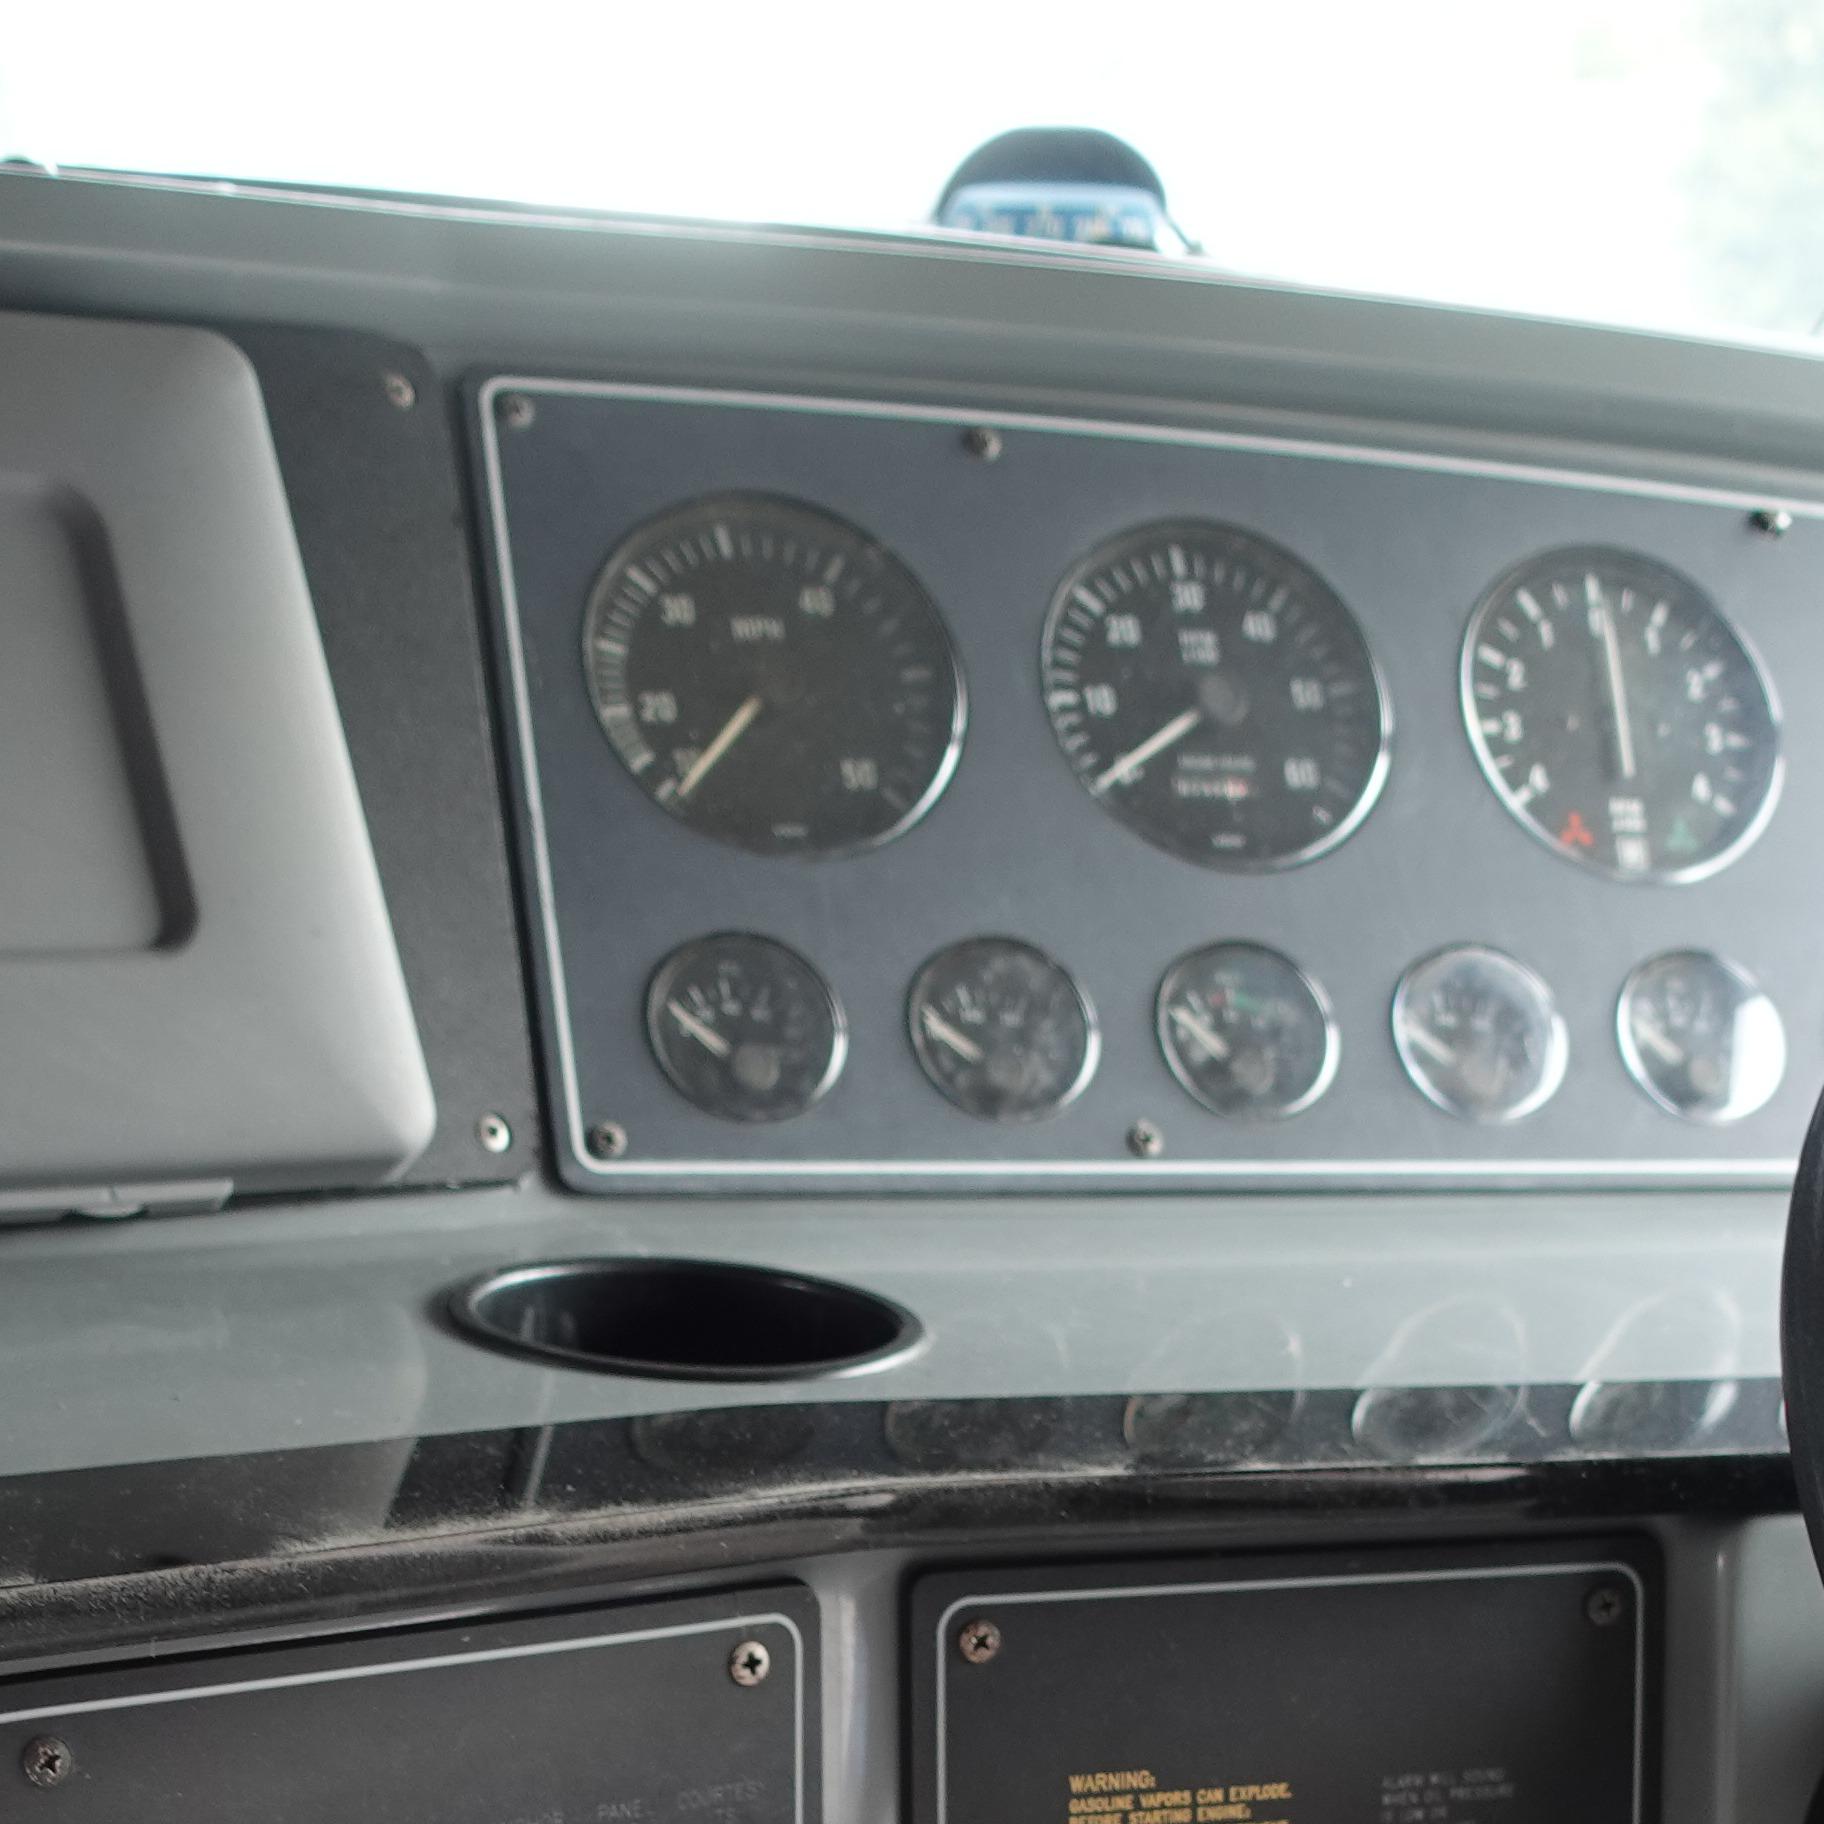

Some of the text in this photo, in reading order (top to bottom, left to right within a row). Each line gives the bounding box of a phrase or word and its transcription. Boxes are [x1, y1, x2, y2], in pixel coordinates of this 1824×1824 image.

[661, 593, 696, 628] 30
[639, 690, 677, 724] 20
[1083, 684, 1118, 718] 10
[1068, 1769, 1157, 1794] WARNING:
[1068, 1794, 1134, 1814] GASOLINE
[1139, 1789, 1192, 1808] VAPORS
[1196, 1788, 1224, 1804] CAN
